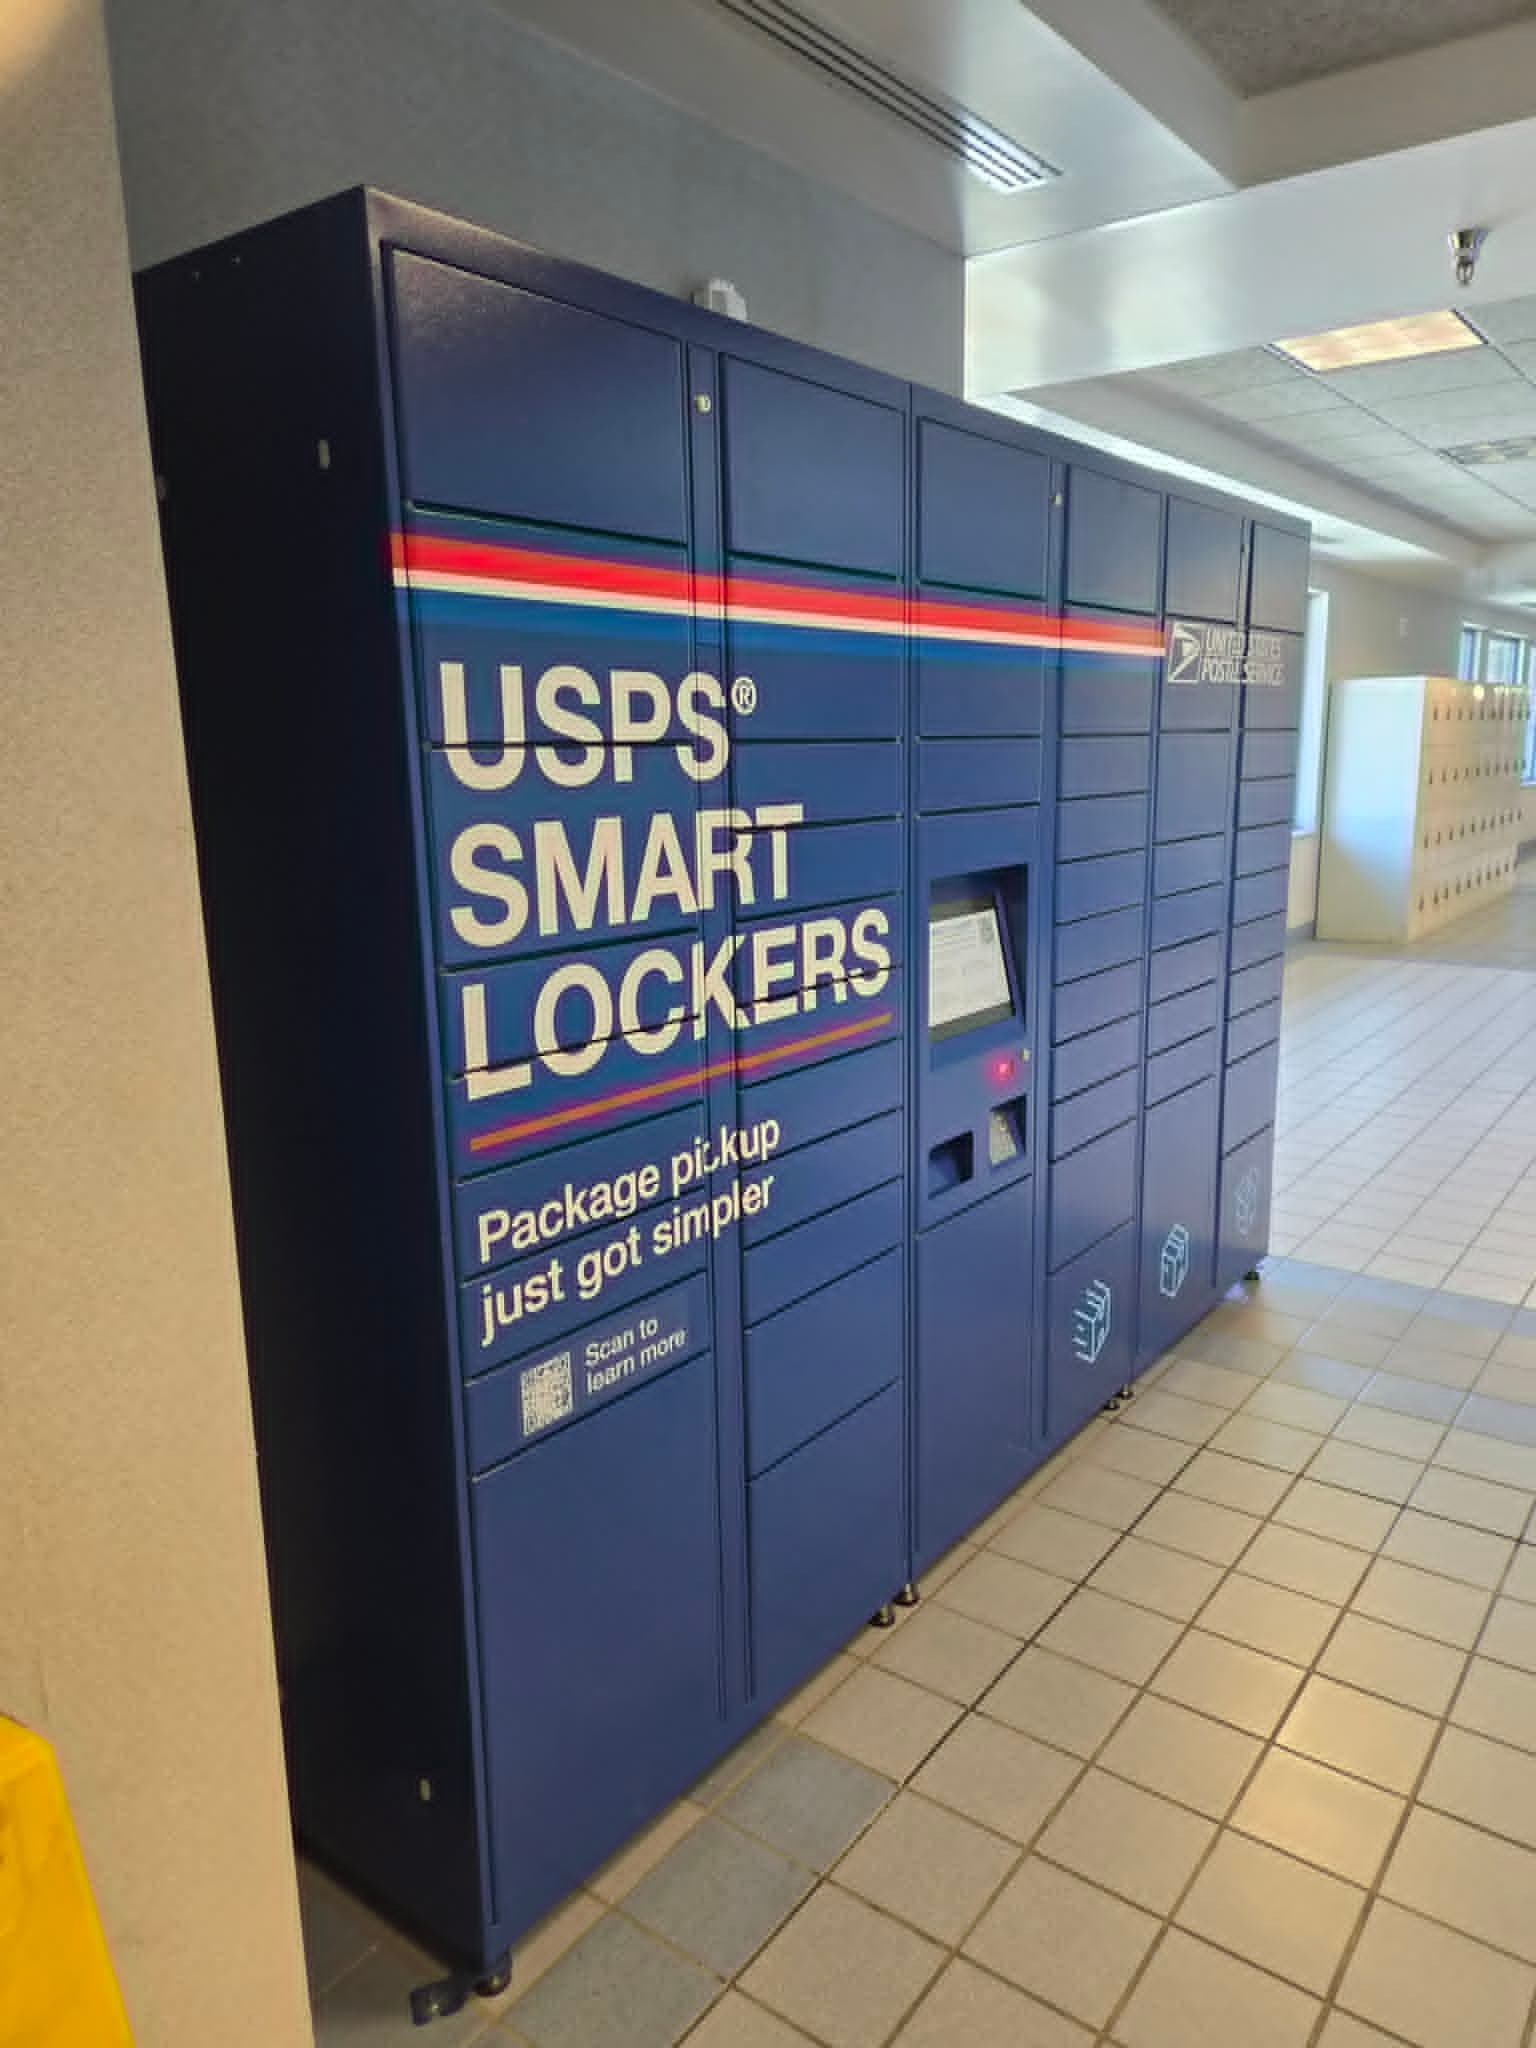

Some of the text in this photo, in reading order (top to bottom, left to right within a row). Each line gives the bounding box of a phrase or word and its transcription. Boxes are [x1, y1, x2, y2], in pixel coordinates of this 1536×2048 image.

[440, 661, 757, 790] USPS®
[450, 803, 803, 947] SMART
[461, 908, 891, 1101] LOCKERS
[478, 1119, 780, 1264] Package pickup
[481, 1175, 775, 1347] just got simpler
[584, 1318, 658, 1367] Scan to
[586, 1328, 687, 1393] learn more
